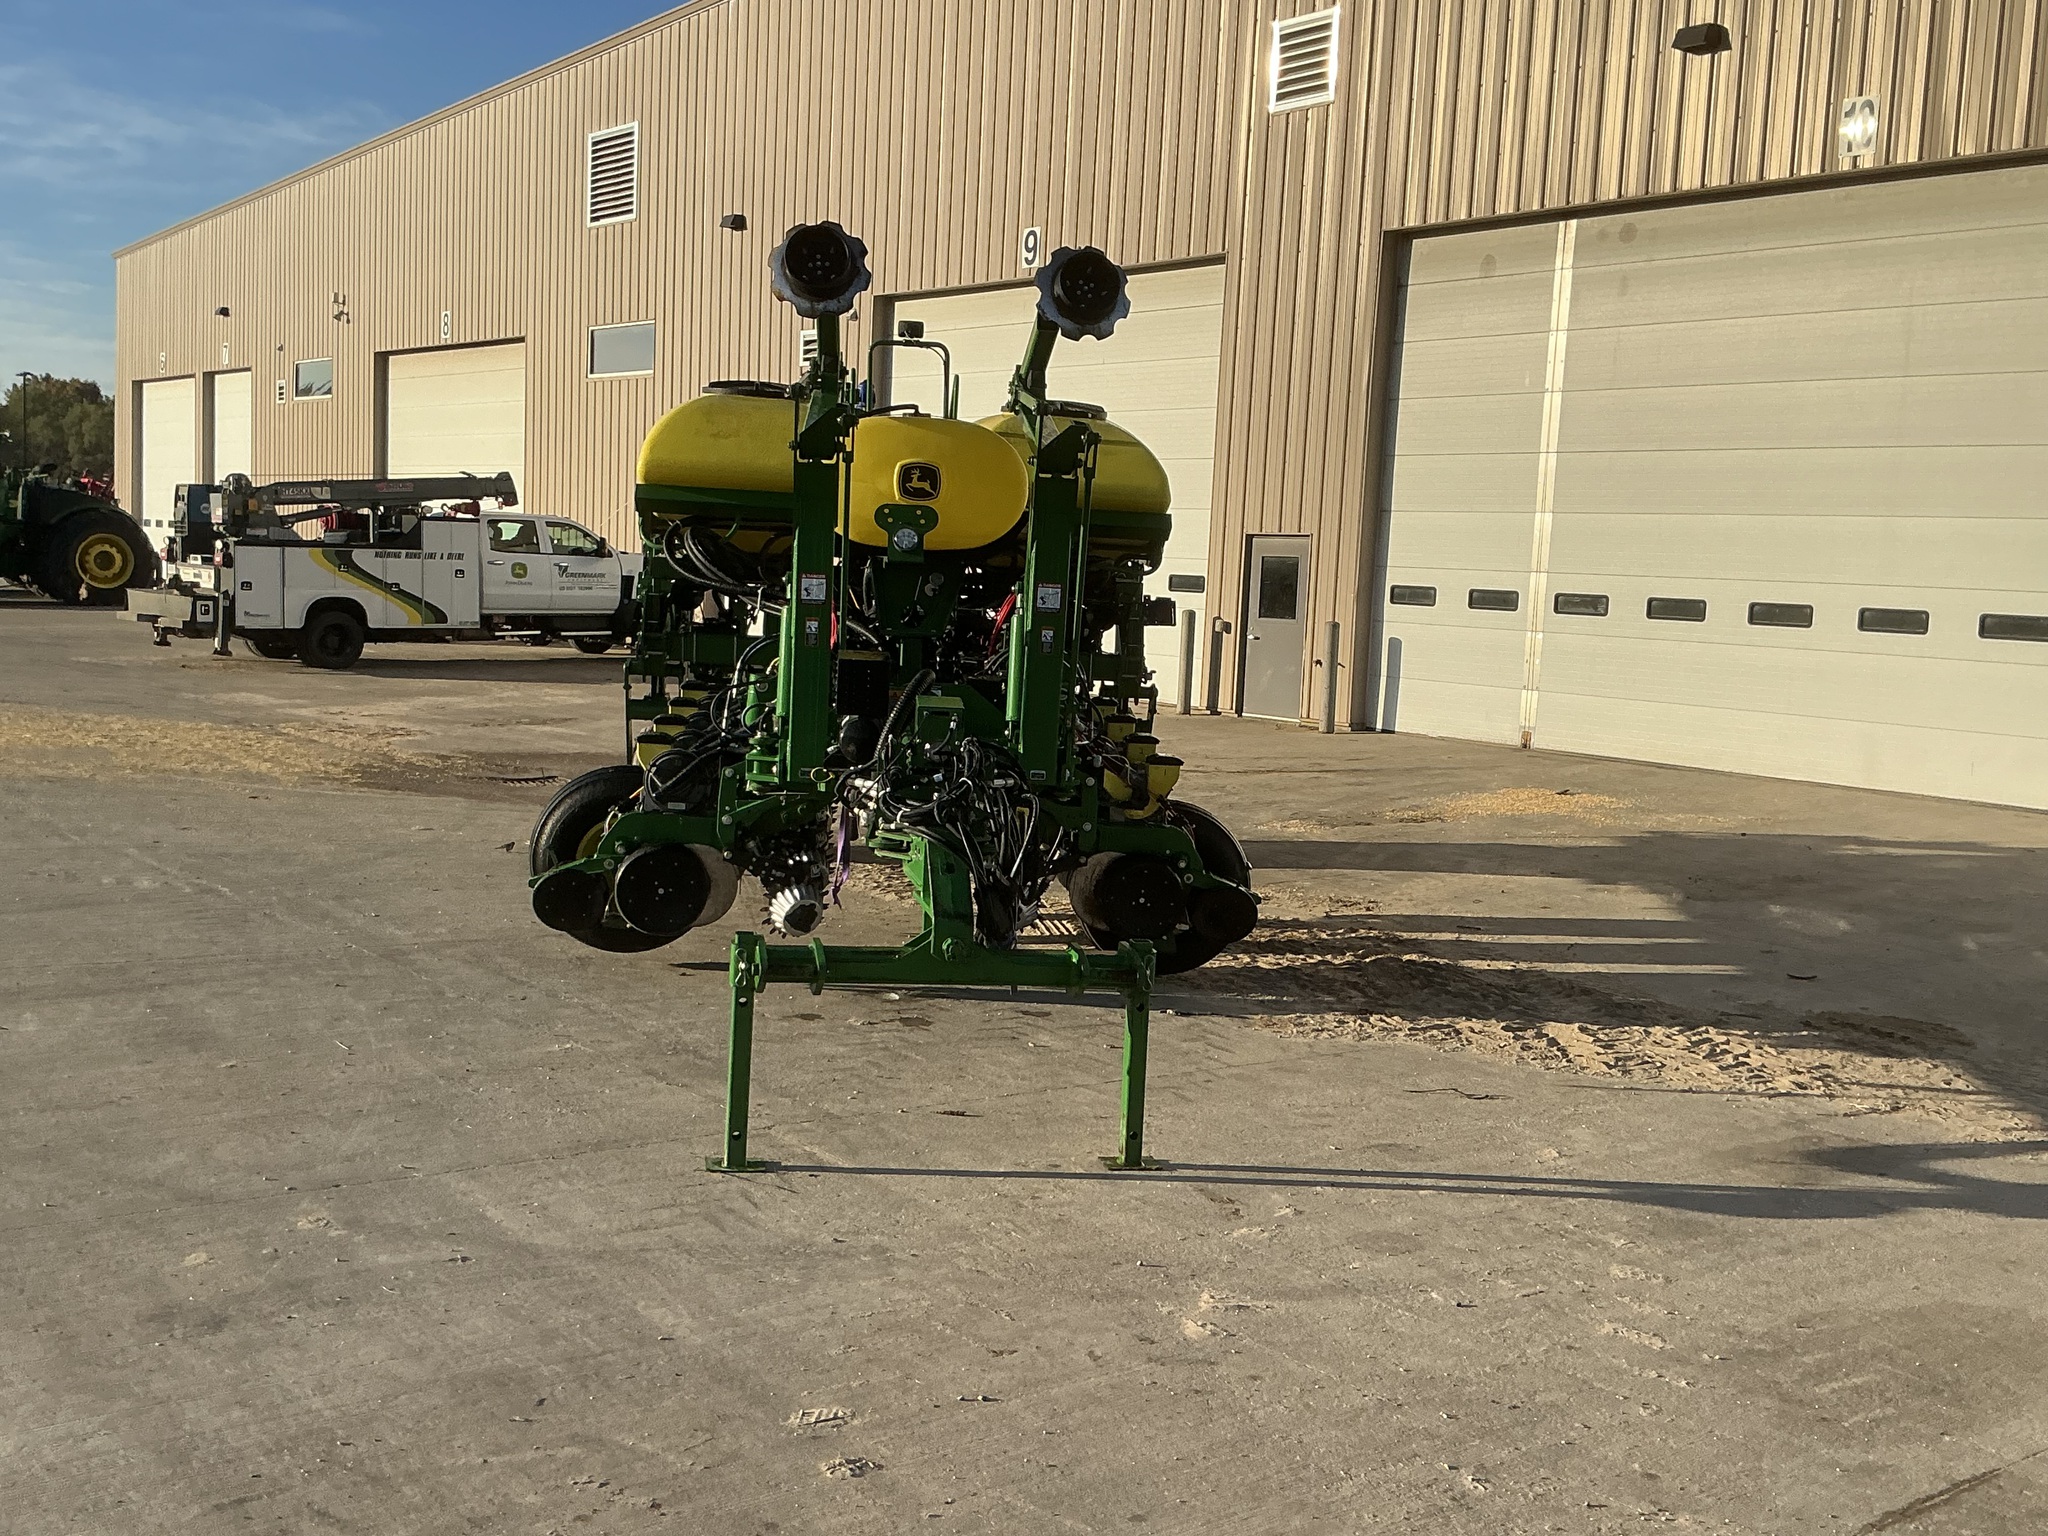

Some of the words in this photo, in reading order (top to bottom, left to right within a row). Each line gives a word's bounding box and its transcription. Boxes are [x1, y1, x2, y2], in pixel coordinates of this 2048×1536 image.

[1844, 99, 1875, 152] 10
[1024, 230, 1038, 266] 9
[443, 313, 449, 336] 8
[374, 551, 402, 559] NOTHING
[405, 552, 422, 560] RUNS
[424, 552, 437, 560] LIKE
[440, 552, 444, 560] A
